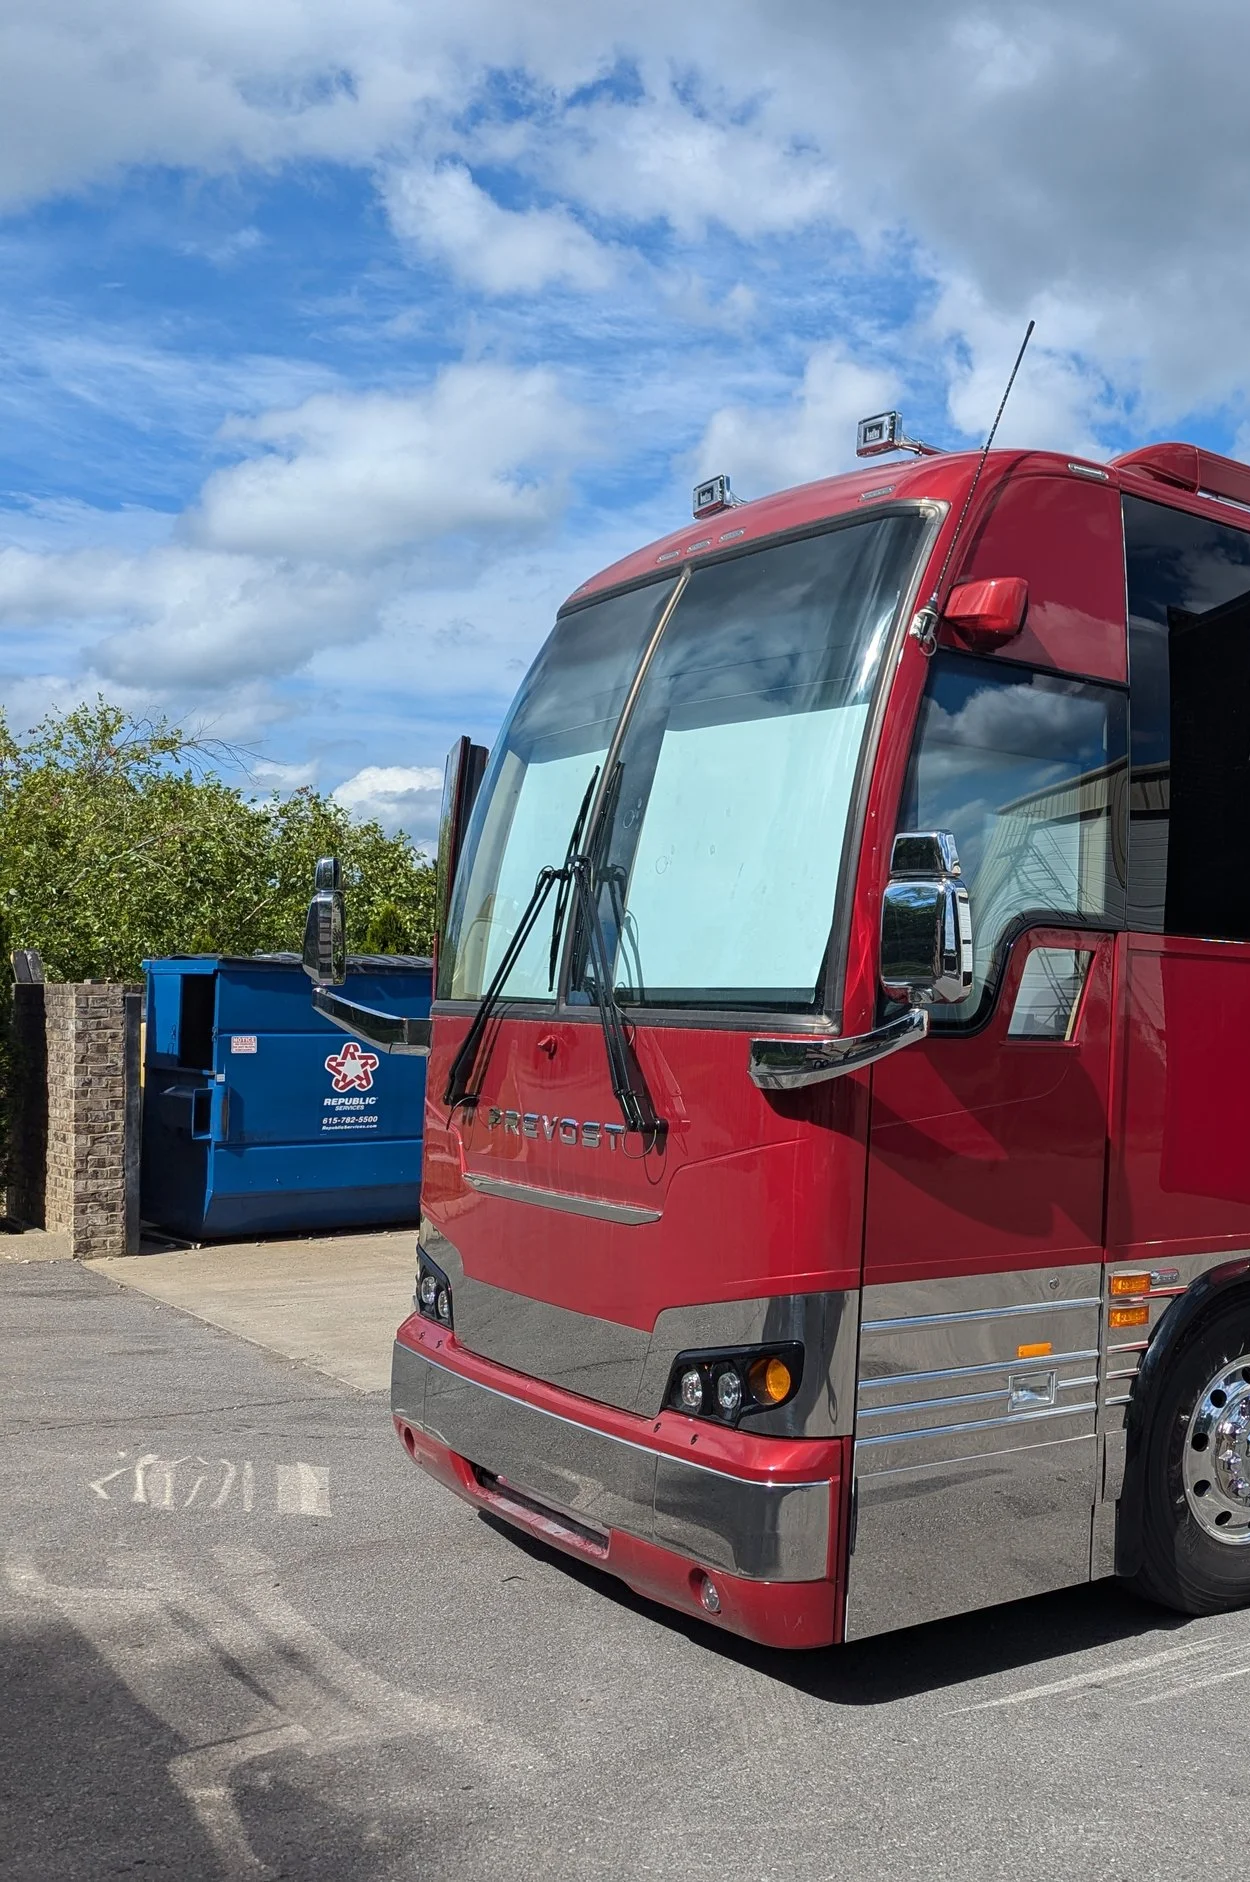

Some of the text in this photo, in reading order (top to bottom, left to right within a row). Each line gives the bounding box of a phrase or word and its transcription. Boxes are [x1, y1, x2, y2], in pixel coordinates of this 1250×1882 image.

[323, 1097, 377, 1106] REPUBLIC
[322, 1116, 378, 1124] 615-782-5500
[488, 1106, 625, 1151] PREVOST
